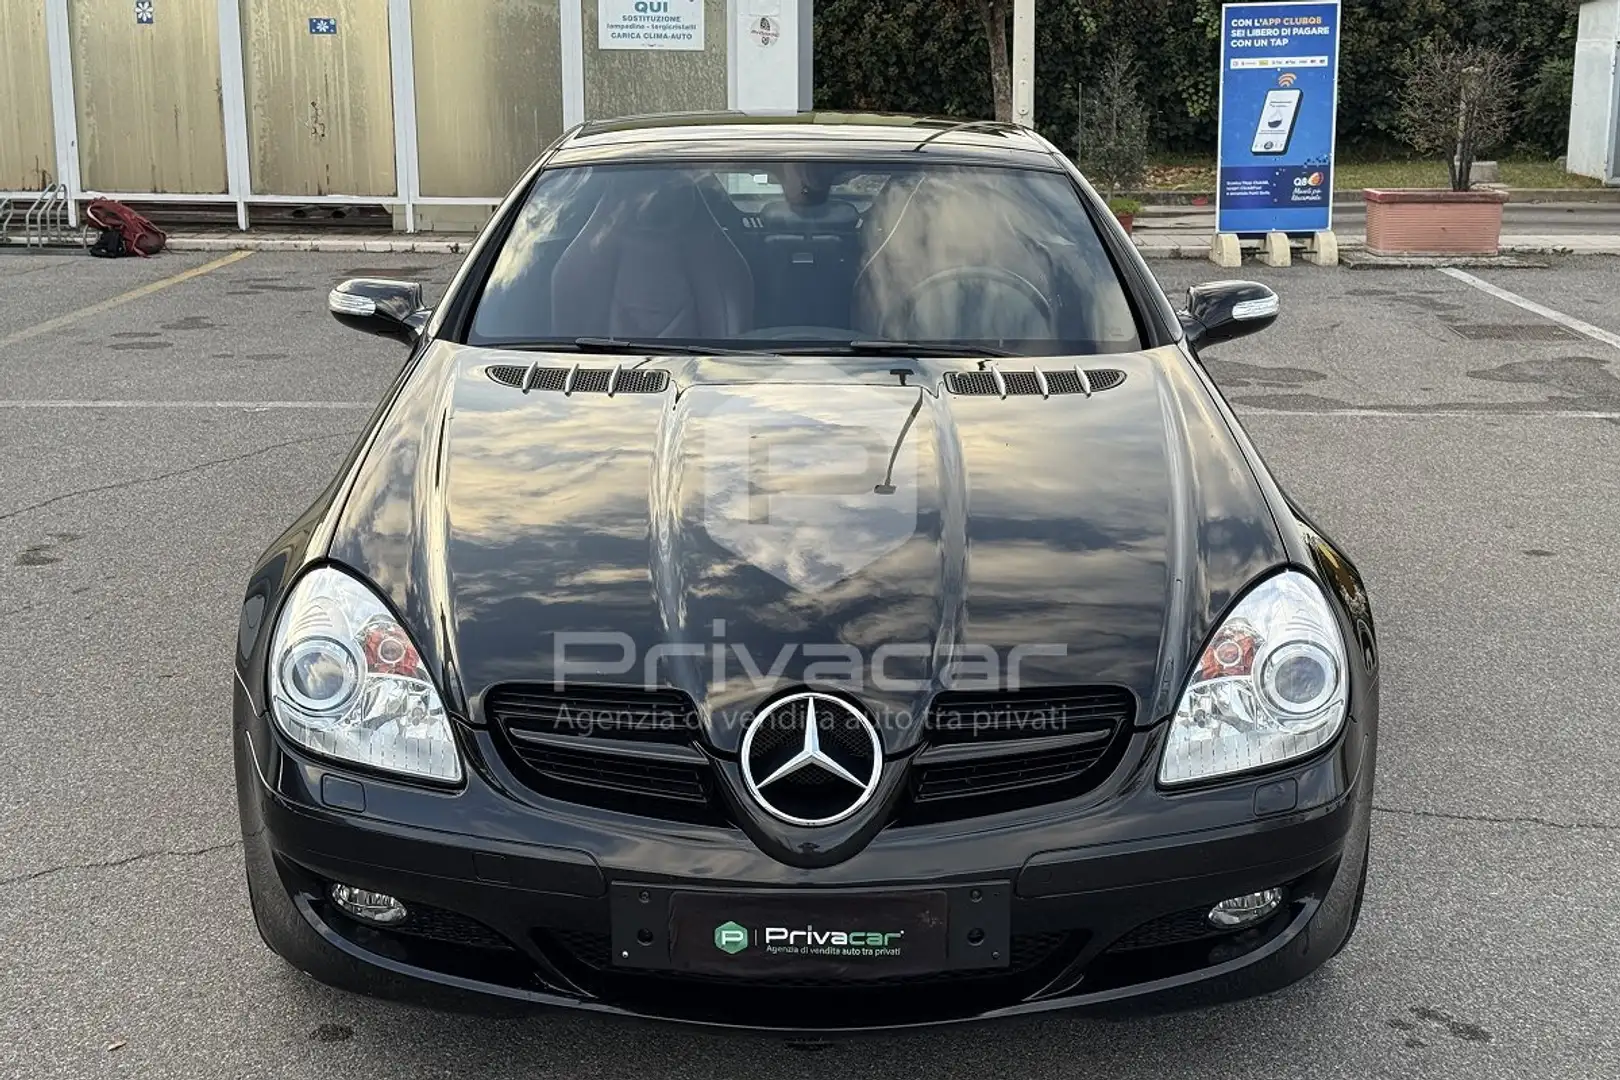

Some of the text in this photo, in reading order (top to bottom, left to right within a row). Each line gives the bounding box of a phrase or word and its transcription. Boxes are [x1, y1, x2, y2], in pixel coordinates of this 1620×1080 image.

[635, 1, 668, 13] QUI
[1231, 18, 1252, 27] CON
[1254, 18, 1280, 26] L'APP
[1231, 27, 1329, 37] SEI LIBERO DI PAGARE
[1231, 39, 1252, 47] CON
[1270, 38, 1288, 46] TAP
[765, 925, 902, 945] Privacar
[766, 944, 901, 957] Agenzia di vendita auto tra privati
